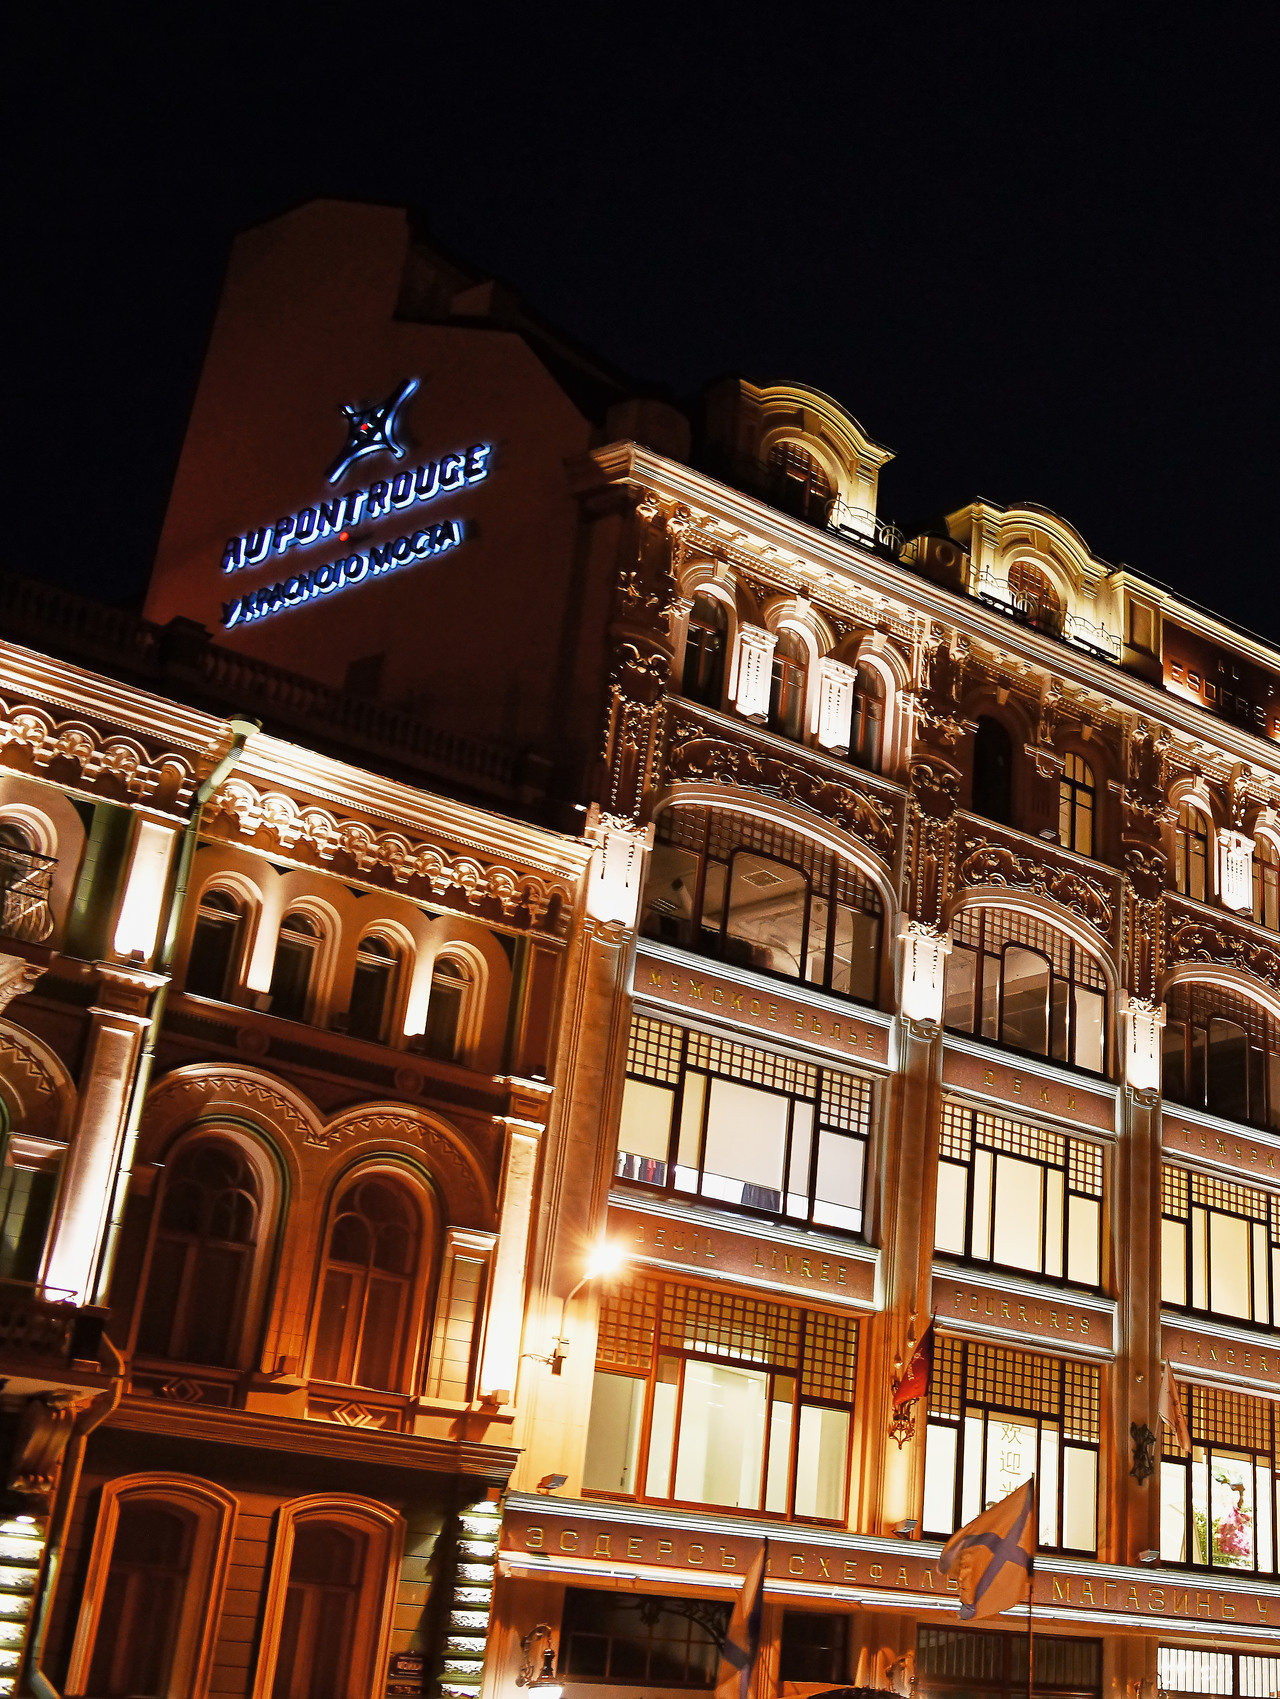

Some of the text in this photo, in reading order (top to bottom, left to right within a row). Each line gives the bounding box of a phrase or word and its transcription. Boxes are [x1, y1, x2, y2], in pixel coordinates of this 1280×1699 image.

[221, 442, 492, 574] AU PONT ROUGE
[221, 518, 466, 629] У КРАСНОГО МОСТА
[648, 966, 778, 1022] МУЖСКОЕ
[754, 1247, 848, 1286] LIVREE
[953, 1290, 1091, 1335] FOURRURES
[999, 1422, 1023, 1498] 欢迎
[525, 1524, 737, 1568] ЭСДЕРСЪ
[788, 1552, 960, 1592] СХЕФАЛЬ
[1052, 1575, 1237, 1619] МАГАЗИНЪ
[1256, 1599, 1270, 1623] У
